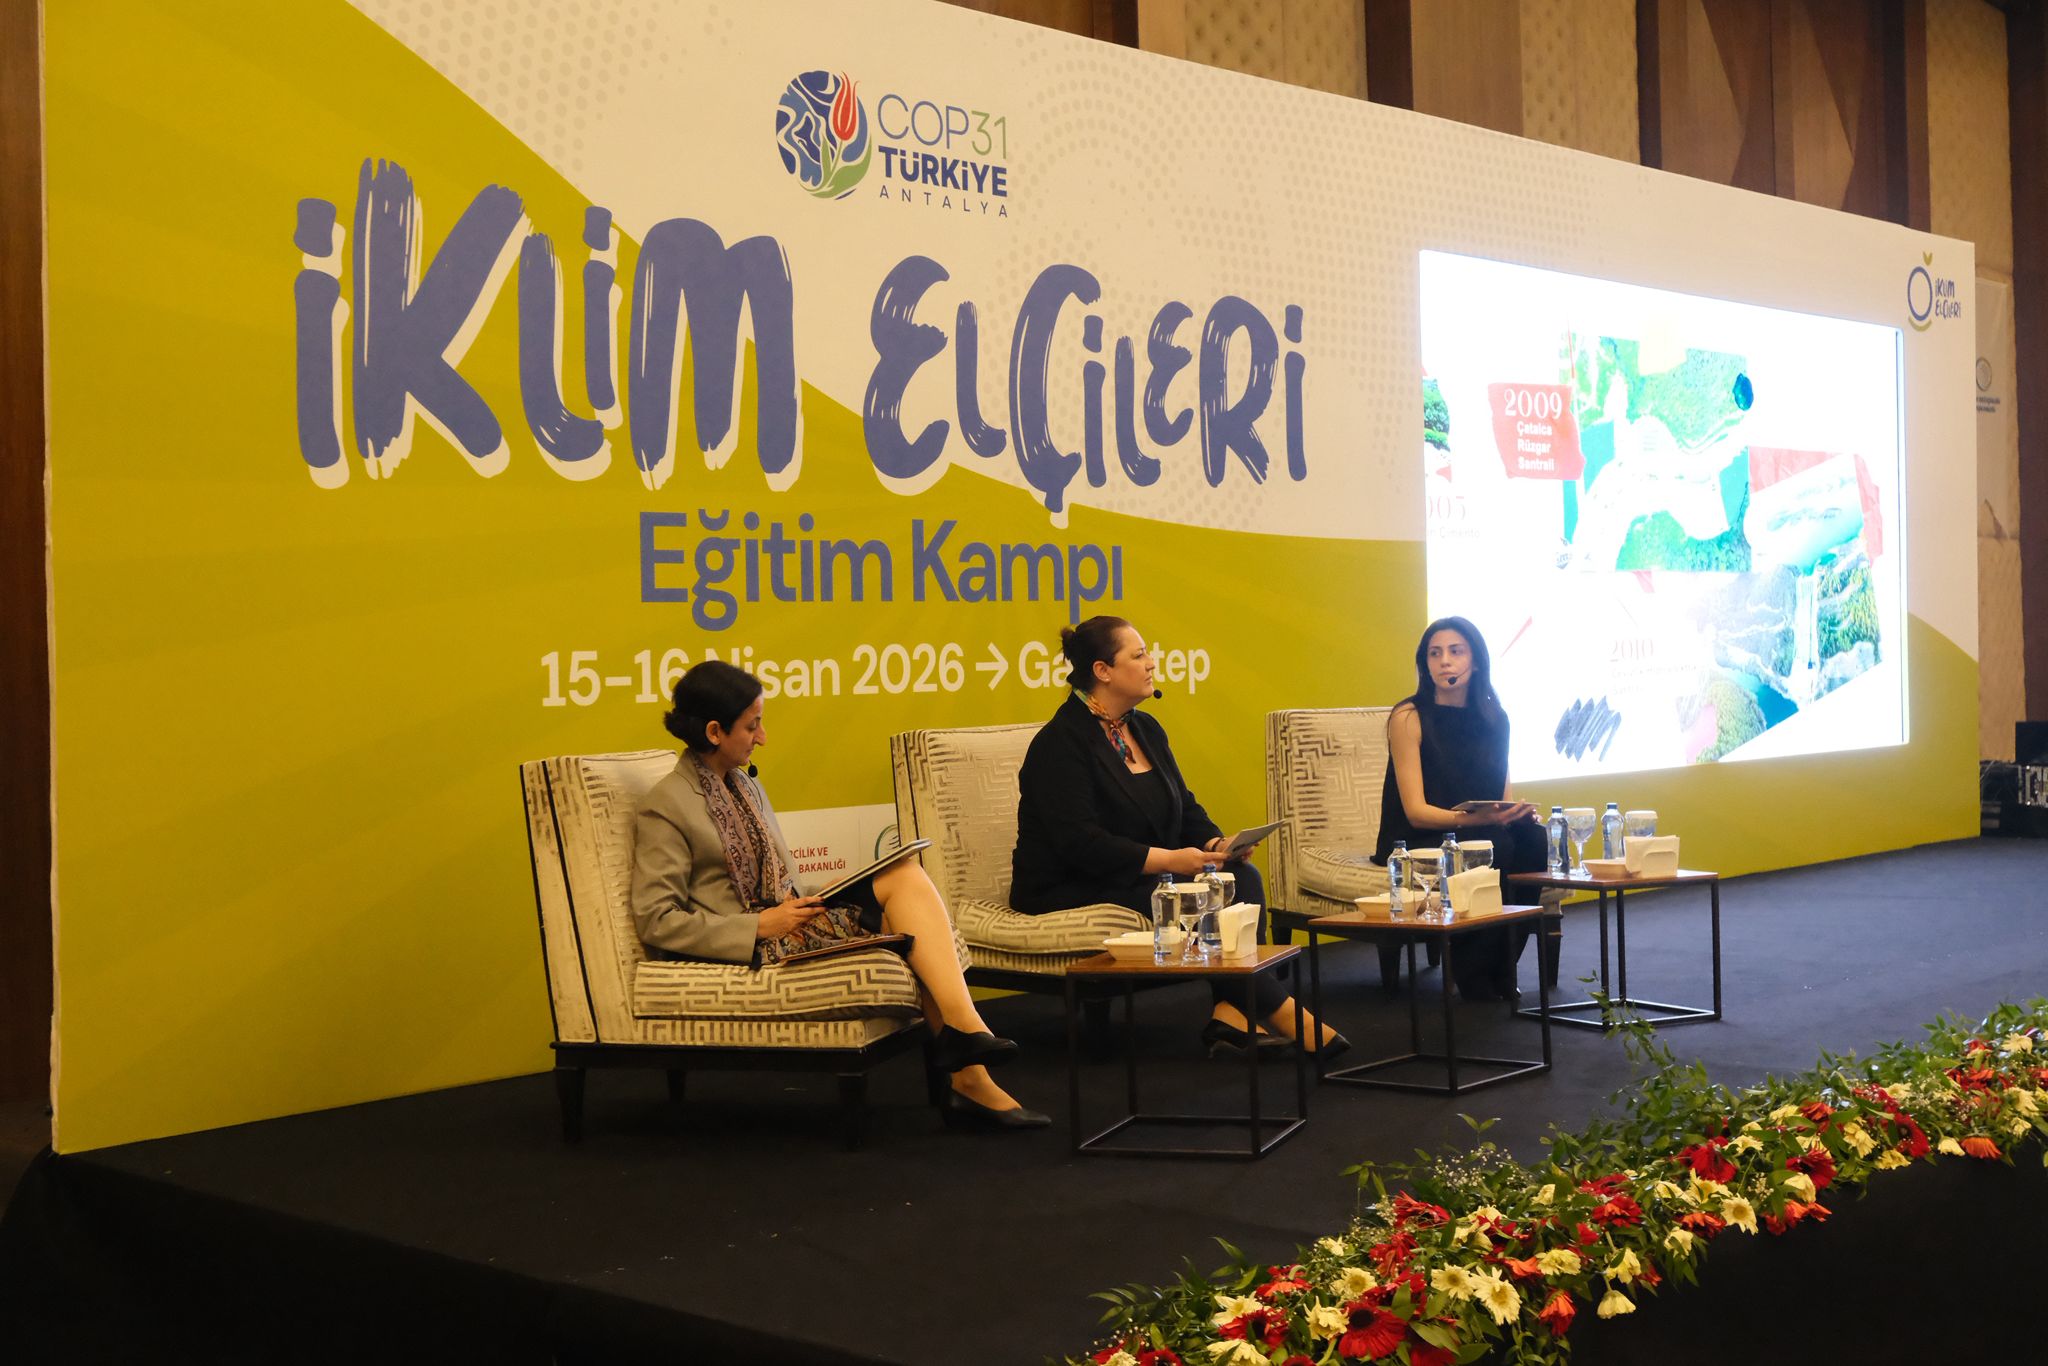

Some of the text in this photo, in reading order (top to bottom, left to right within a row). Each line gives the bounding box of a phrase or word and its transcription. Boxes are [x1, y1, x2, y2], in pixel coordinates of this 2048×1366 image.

[877, 93, 1007, 160] COP31
[879, 184, 1008, 218] ANTALYA
[1503, 388, 1562, 419] 2009
[1517, 438, 1552, 456] Rüzgar
[639, 508, 1124, 632] Eğitim Kampı
[852, 642, 965, 695] 2026
[1018, 640, 1211, 694] Gatep
[798, 858, 846, 873] BAKANLIĞI
[816, 846, 828, 856] VE
